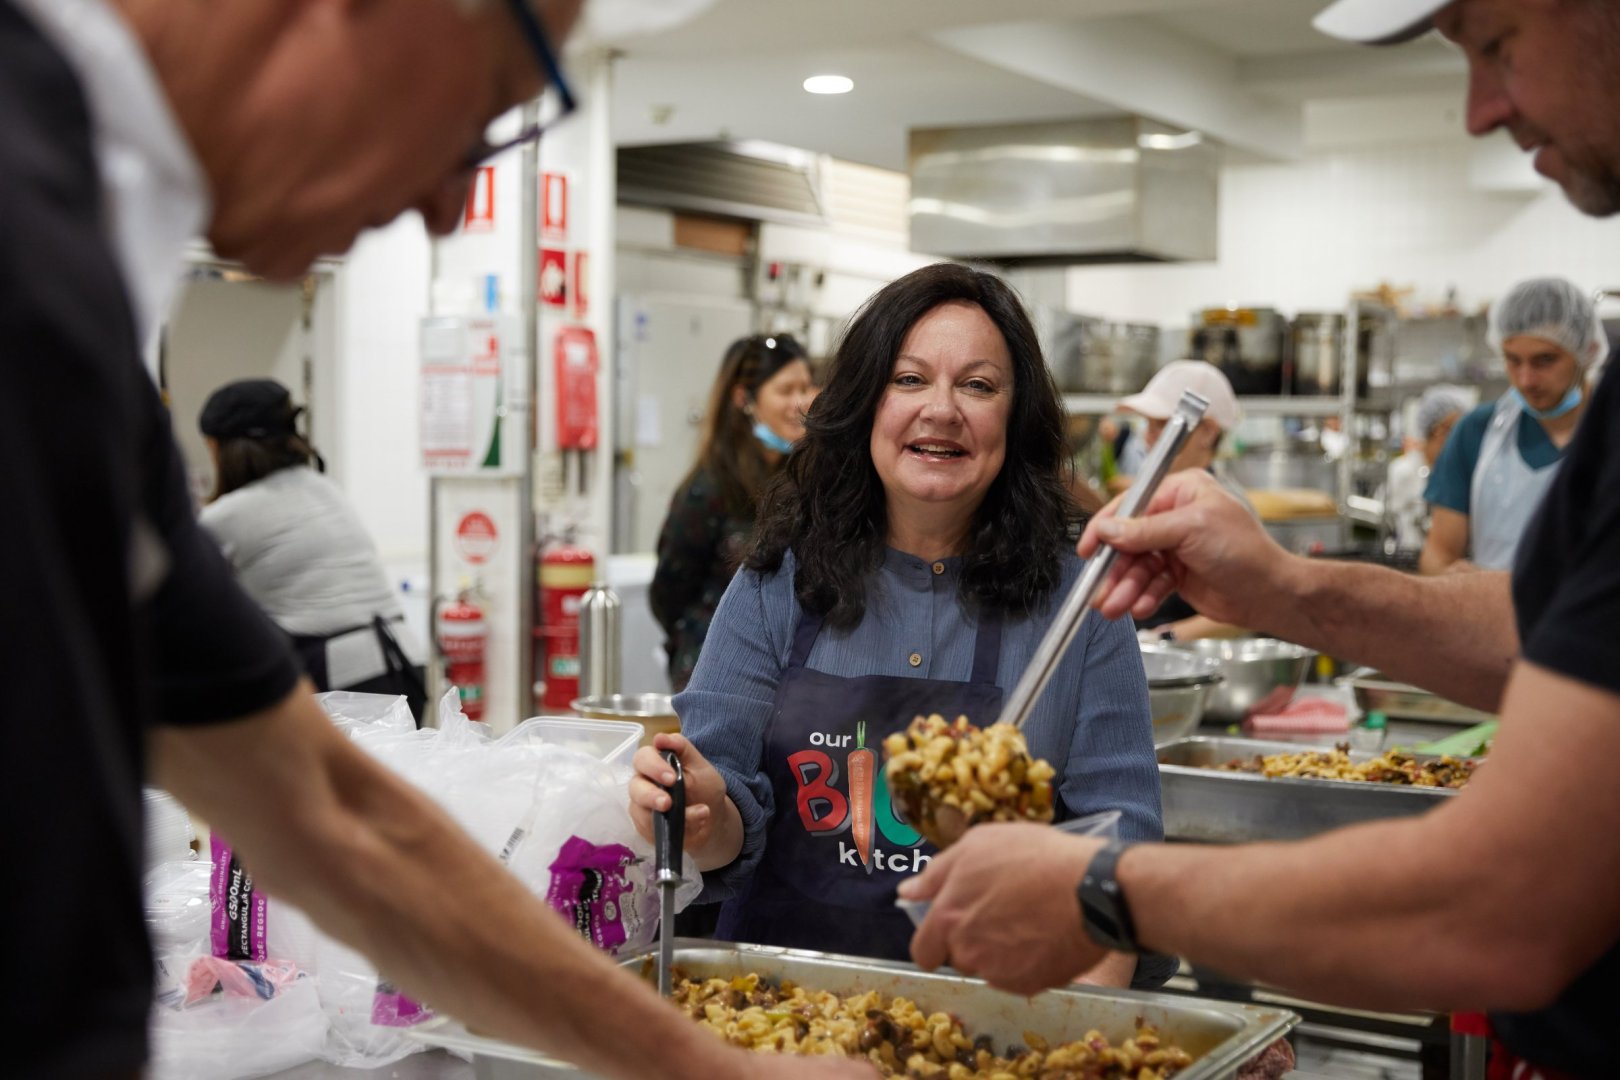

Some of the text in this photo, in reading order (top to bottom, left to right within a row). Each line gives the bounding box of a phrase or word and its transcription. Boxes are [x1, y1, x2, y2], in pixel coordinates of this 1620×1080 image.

[809, 731, 852, 748] our
[244, 876, 252, 892] CO
[229, 868, 242, 921] G500mL
